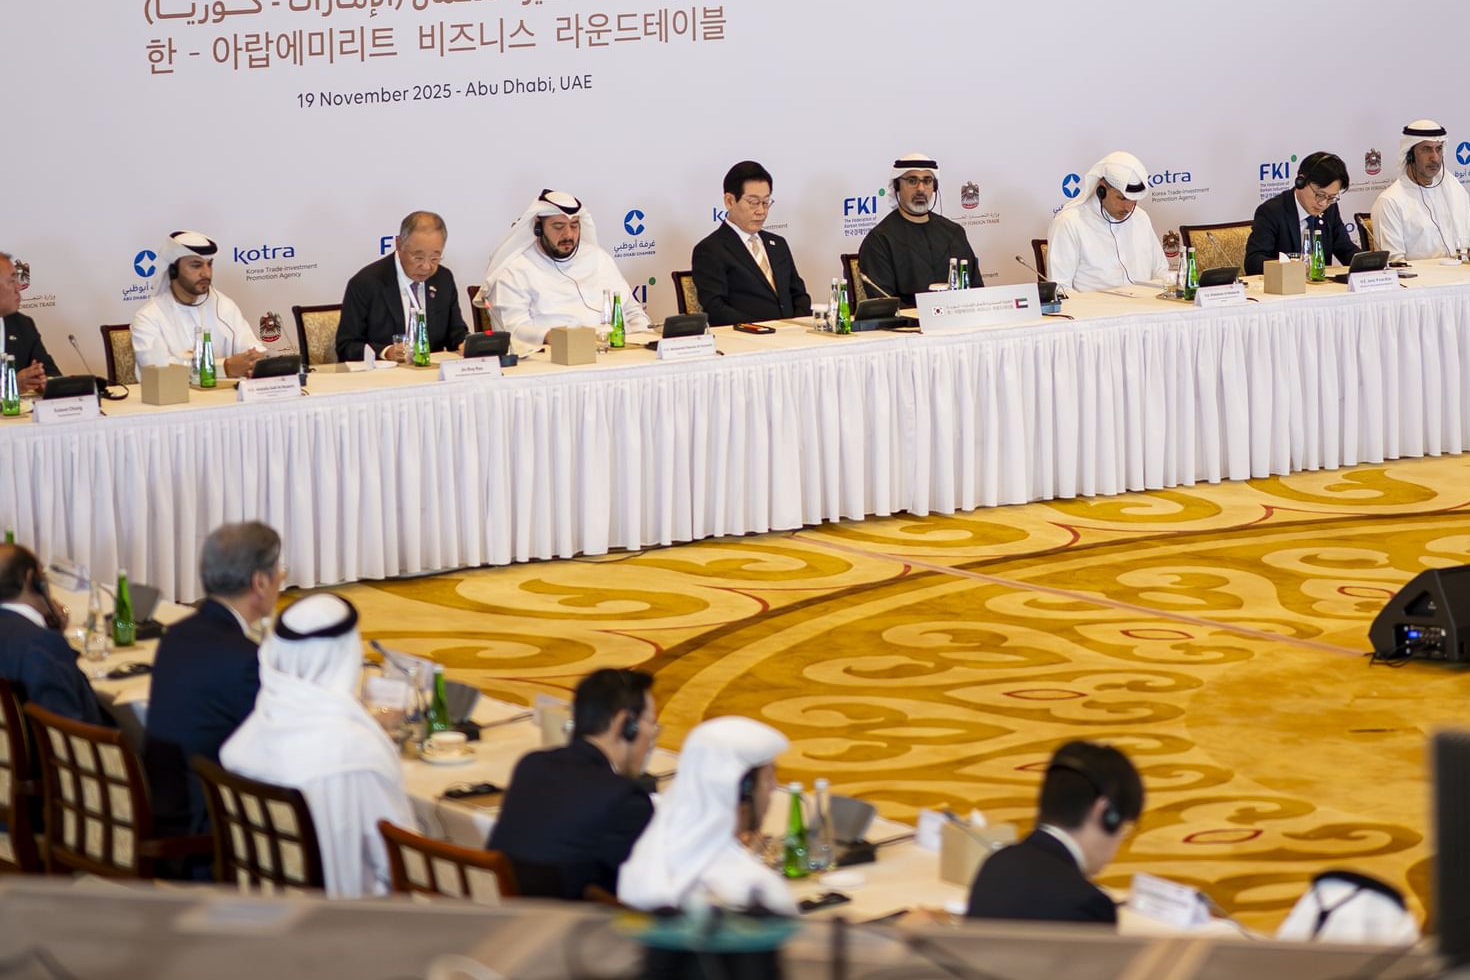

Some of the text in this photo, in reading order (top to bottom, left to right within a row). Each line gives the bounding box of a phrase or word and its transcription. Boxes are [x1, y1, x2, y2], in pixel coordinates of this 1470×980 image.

[146, 37, 178, 75] 한
[212, 25, 398, 71] 아랍에미리트
[418, 17, 537, 58] 비즈니스
[556, 5, 727, 50] 라운드테이블
[297, 92, 315, 109] 19
[320, 87, 409, 107] November
[413, 83, 452, 102] 2025
[465, 81, 499, 98] Abu
[503, 76, 555, 96] Dhabi,
[560, 74, 593, 91] UAE
[1260, 162, 1289, 180] FKI
[844, 196, 877, 216] FKI
[233, 245, 295, 264] kotra
[613, 238, 656, 253] غرفة أبوظبي
[279, 272, 301, 280] Agency
